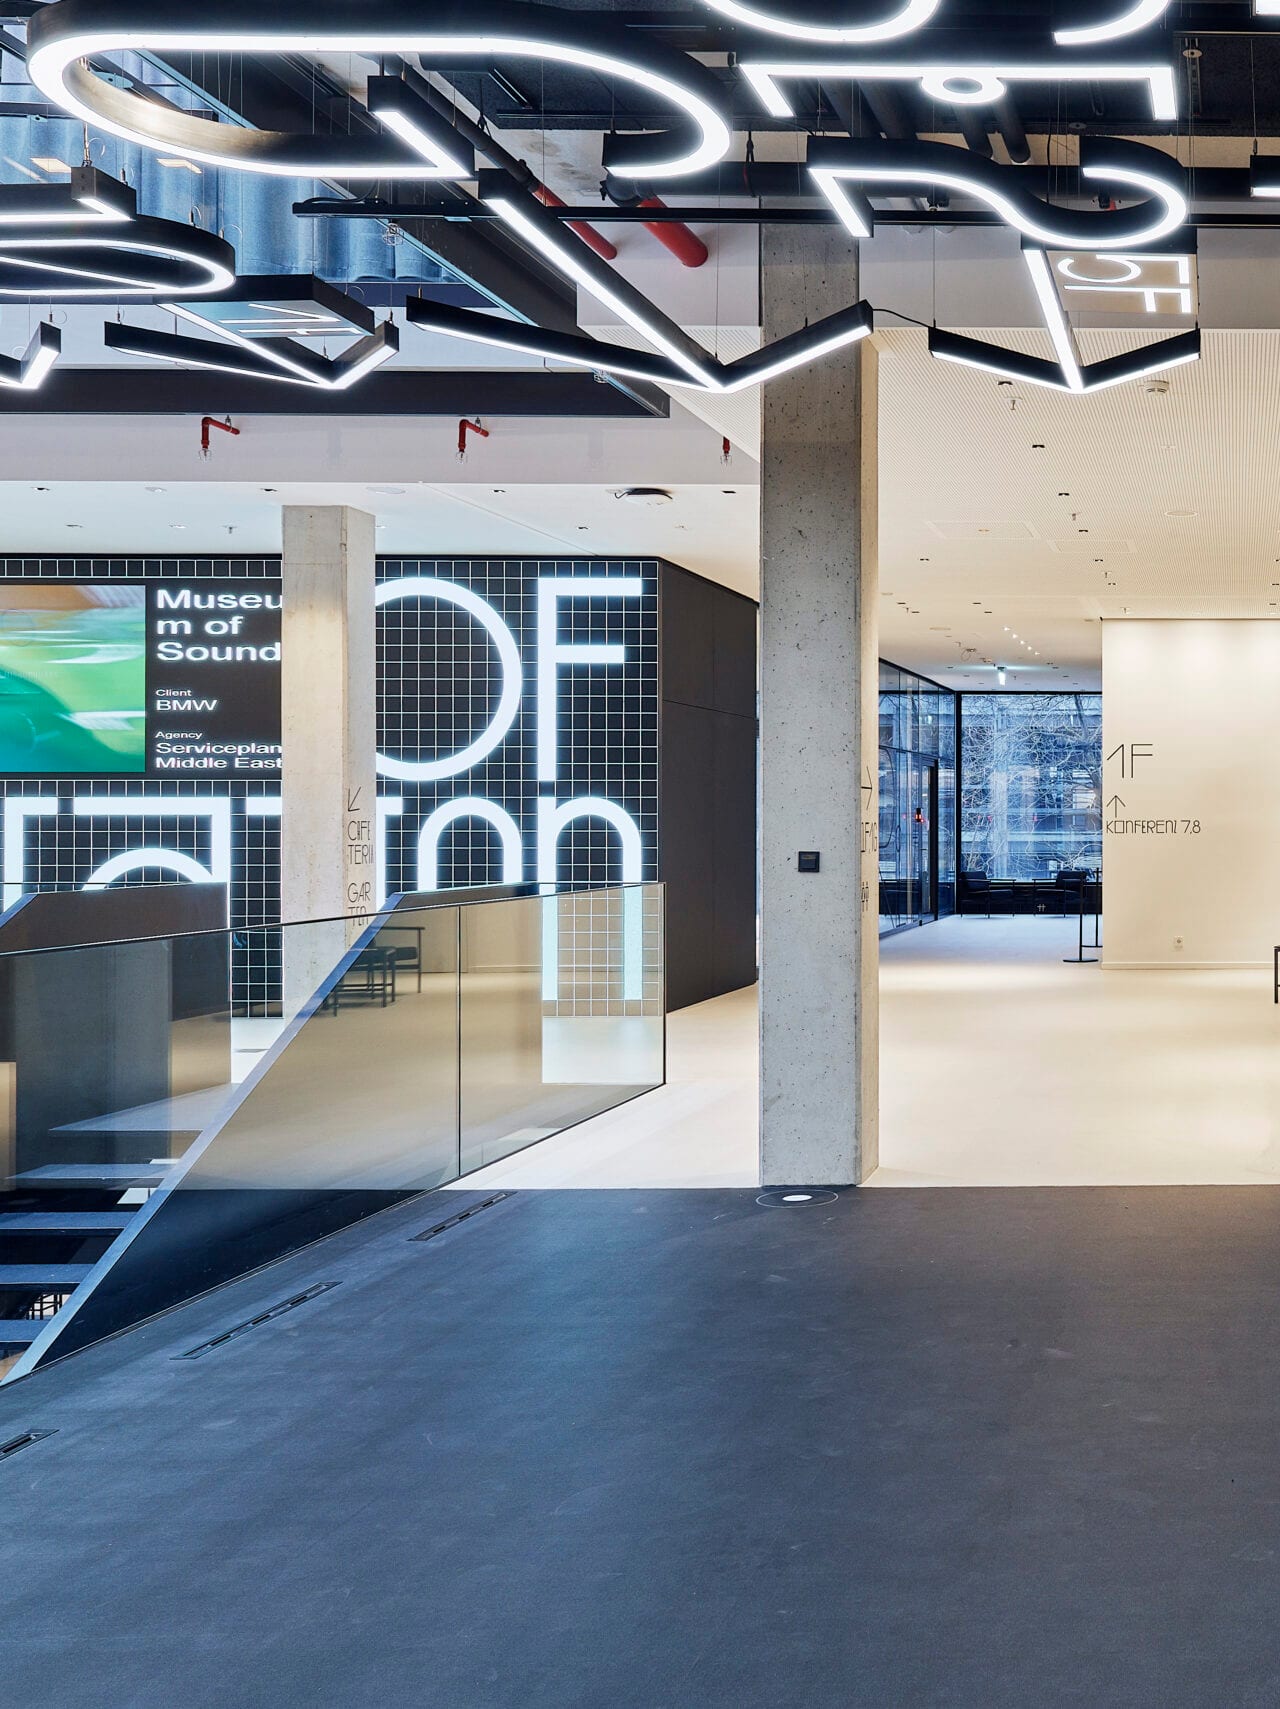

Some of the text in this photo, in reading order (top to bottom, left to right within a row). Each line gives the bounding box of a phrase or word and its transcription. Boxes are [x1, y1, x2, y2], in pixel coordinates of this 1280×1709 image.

[156, 589, 282, 609] Museu
[157, 616, 244, 635] m of
[156, 641, 281, 661] Sound
[155, 689, 192, 697] Client
[156, 699, 217, 711] BMW
[155, 731, 202, 740] Agency
[156, 742, 282, 756] Serviceplan
[156, 757, 282, 768] Middle East
[1106, 744, 1153, 778] 1F
[347, 882, 371, 903] GAR
